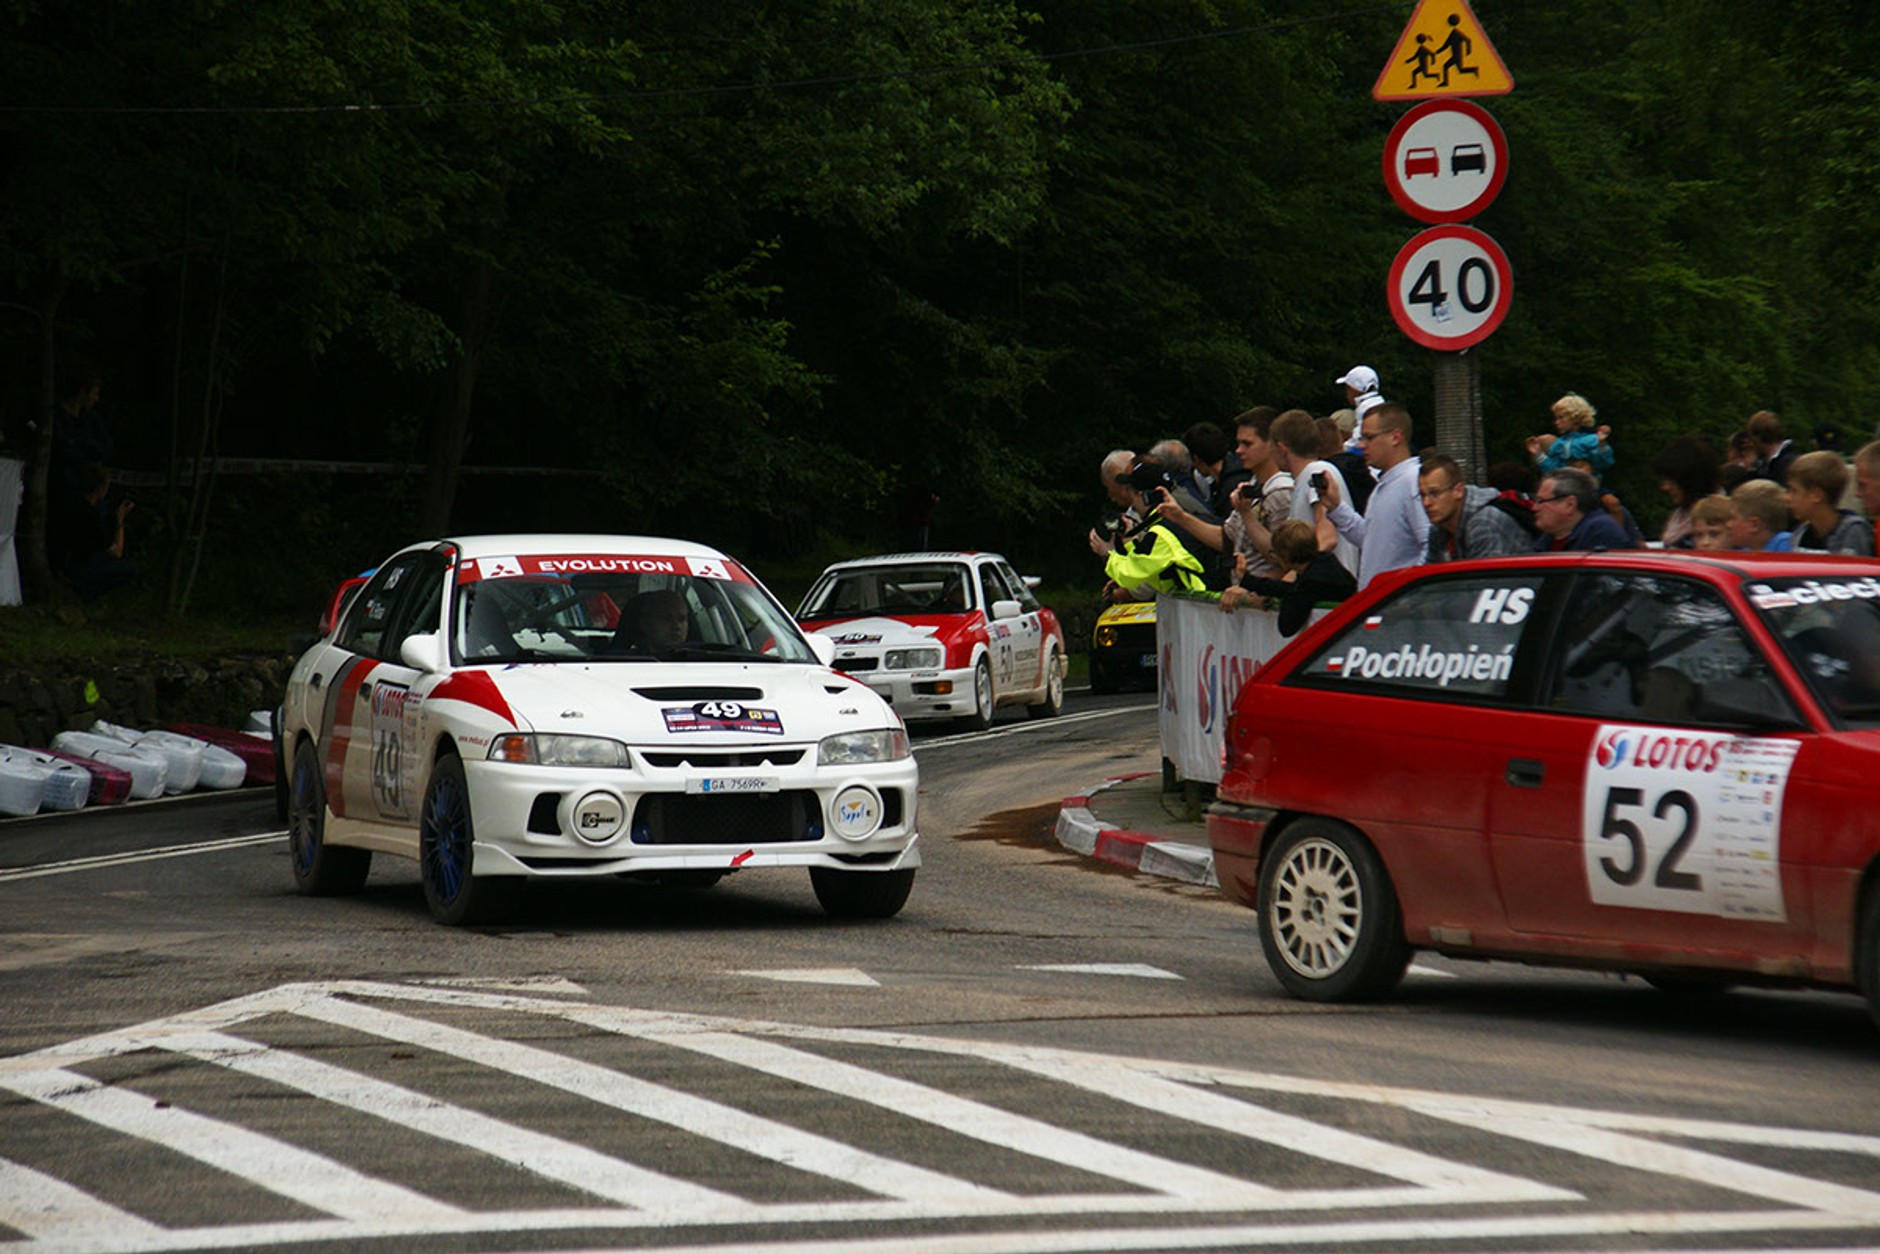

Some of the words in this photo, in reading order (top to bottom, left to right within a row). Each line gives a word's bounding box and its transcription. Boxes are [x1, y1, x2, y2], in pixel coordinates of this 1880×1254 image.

[1408, 256, 1495, 317] 40
[538, 559, 674, 572] EVOLUTION
[1469, 587, 1536, 625] HS
[1341, 644, 1515, 687] Pochłopień
[701, 701, 742, 718] 49
[374, 729, 400, 807] 49
[1633, 735, 1727, 773] LOTOS
[1598, 786, 1705, 891] 52
